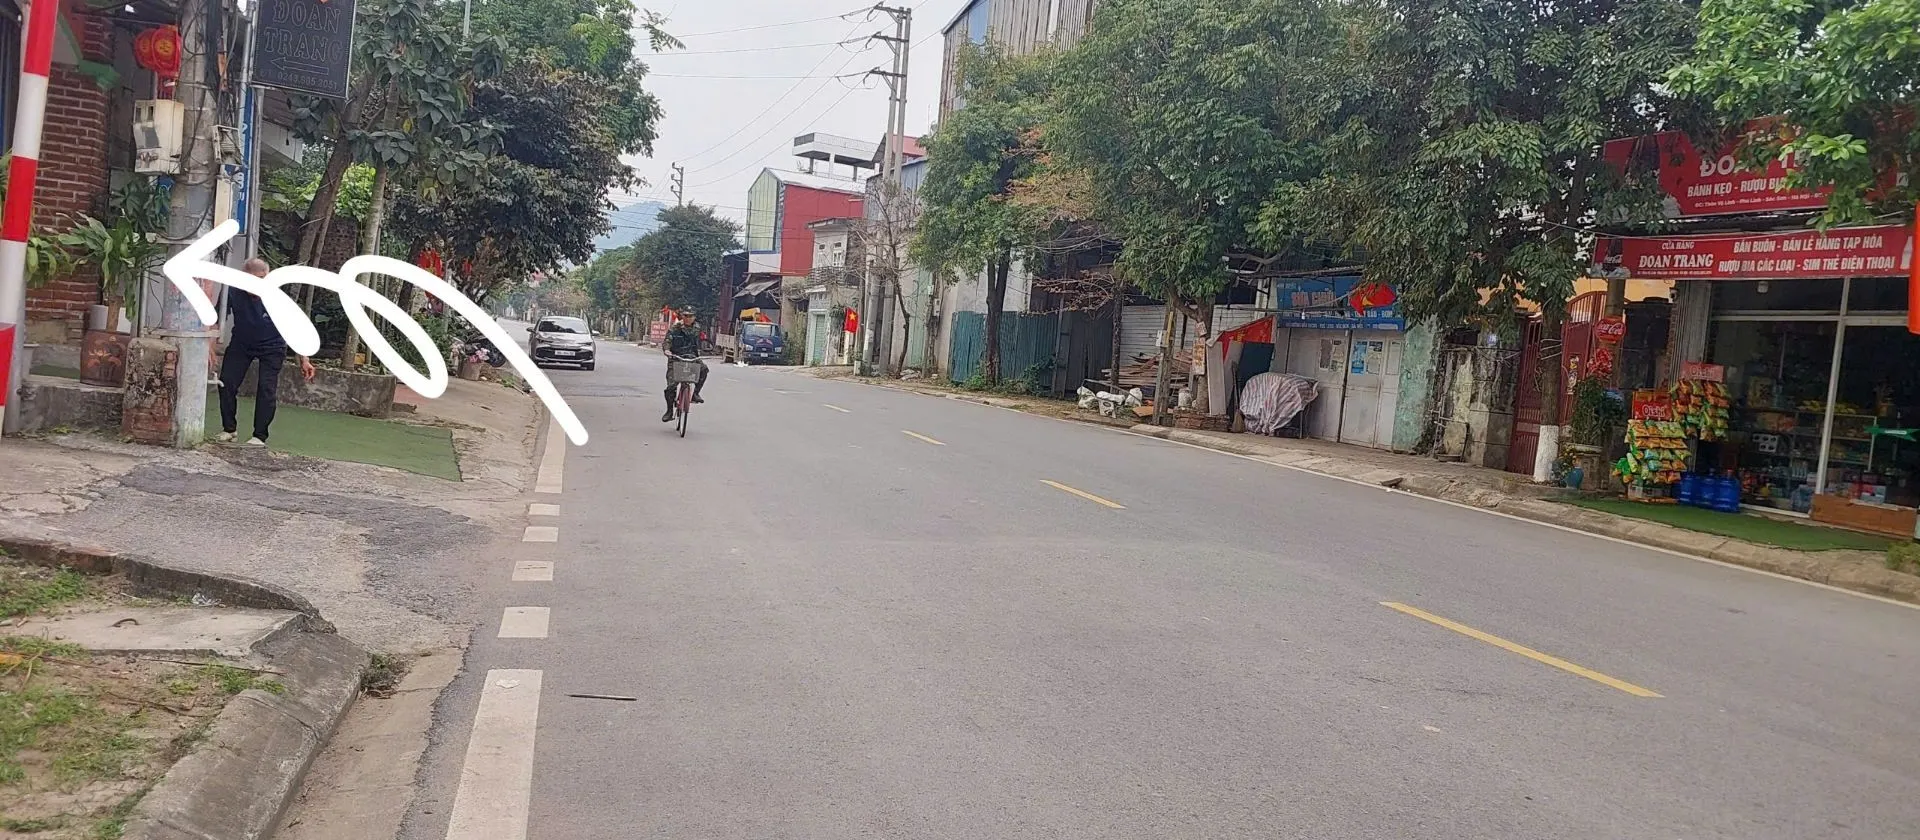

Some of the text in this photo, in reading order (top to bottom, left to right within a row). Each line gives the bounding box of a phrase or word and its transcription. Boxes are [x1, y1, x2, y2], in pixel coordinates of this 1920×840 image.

[264, 26, 342, 64] TRANG
[1687, 184, 1711, 197] BÁNH
[1714, 182, 1732, 197] KẸO
[1740, 178, 1767, 194] RƯỢU
[1662, 240, 1695, 250] CỬA HÀNG
[1733, 240, 1751, 253] BÁN
[1752, 239, 1775, 253] BUÔN
[1782, 239, 1801, 252] BÁN
[1803, 237, 1814, 251] LẺ
[1815, 236, 1841, 250] HÀNG
[1842, 236, 1861, 252] TẠP
[1863, 235, 1883, 249] HÓA
[1638, 255, 1671, 268] ĐOAN
[1673, 253, 1714, 268] TRANG
[1718, 259, 1741, 274] RƯỢU
[1741, 259, 1756, 272] BIA
[1757, 258, 1775, 272] CÁC
[1775, 258, 1795, 274] LOẠI
[1802, 257, 1821, 271] SIM
[1822, 254, 1841, 270] THẺ
[1841, 255, 1864, 272] ĐIỆN
[1866, 255, 1896, 273] THOẠI
[1642, 404, 1667, 418] Oishi
